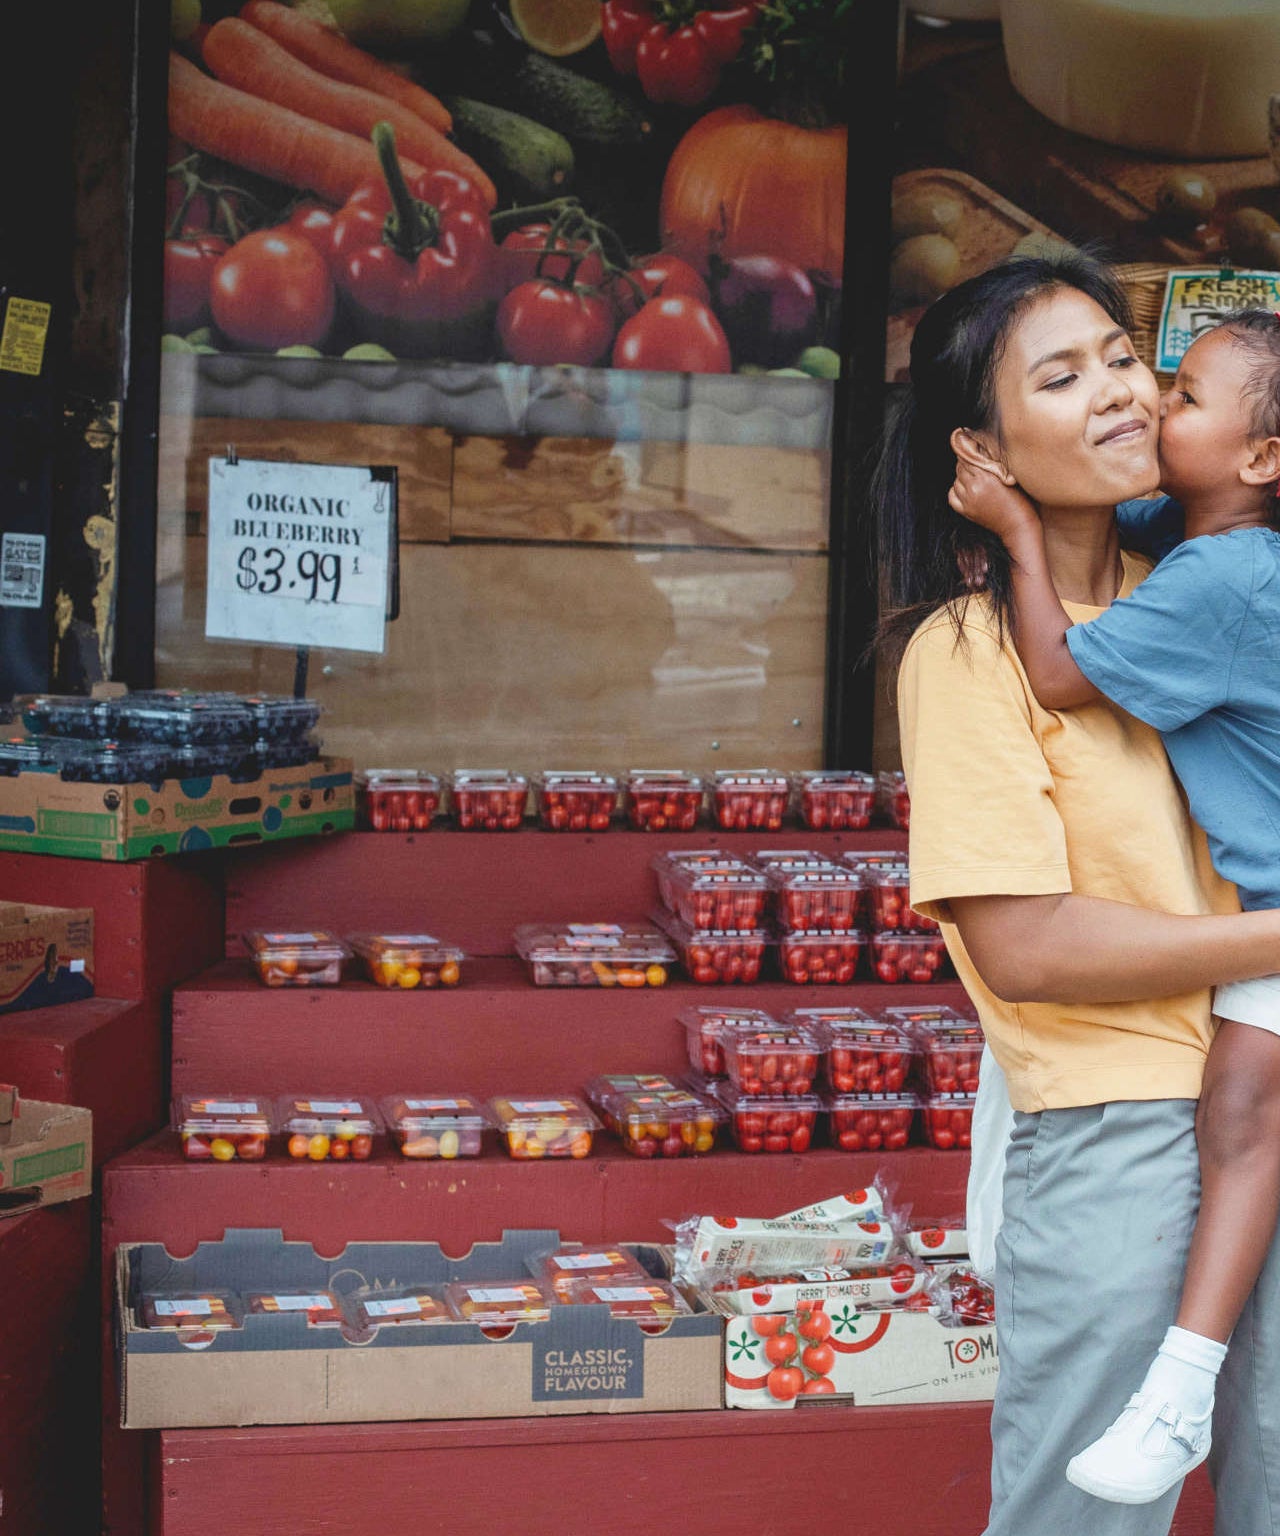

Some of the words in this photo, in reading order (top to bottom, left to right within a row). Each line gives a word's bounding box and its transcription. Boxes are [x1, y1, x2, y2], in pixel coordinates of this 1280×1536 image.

[1184, 278, 1267, 295] FRESH
[247, 492, 350, 518] ORGANIC
[233, 519, 364, 546] BLUEBERRY
[236, 546, 341, 603] $3.99
[797, 1288, 822, 1299] CHERRY
[826, 1283, 871, 1298] TOMATOES
[545, 1348, 633, 1368] CLASSIC,
[944, 1333, 999, 1369] TOM
[545, 1365, 626, 1376] HOMEGROWN
[932, 1377, 949, 1387] ON
[953, 1370, 975, 1381] THE
[979, 1365, 999, 1376] VIN
[545, 1376, 626, 1392] FLAVOUR
